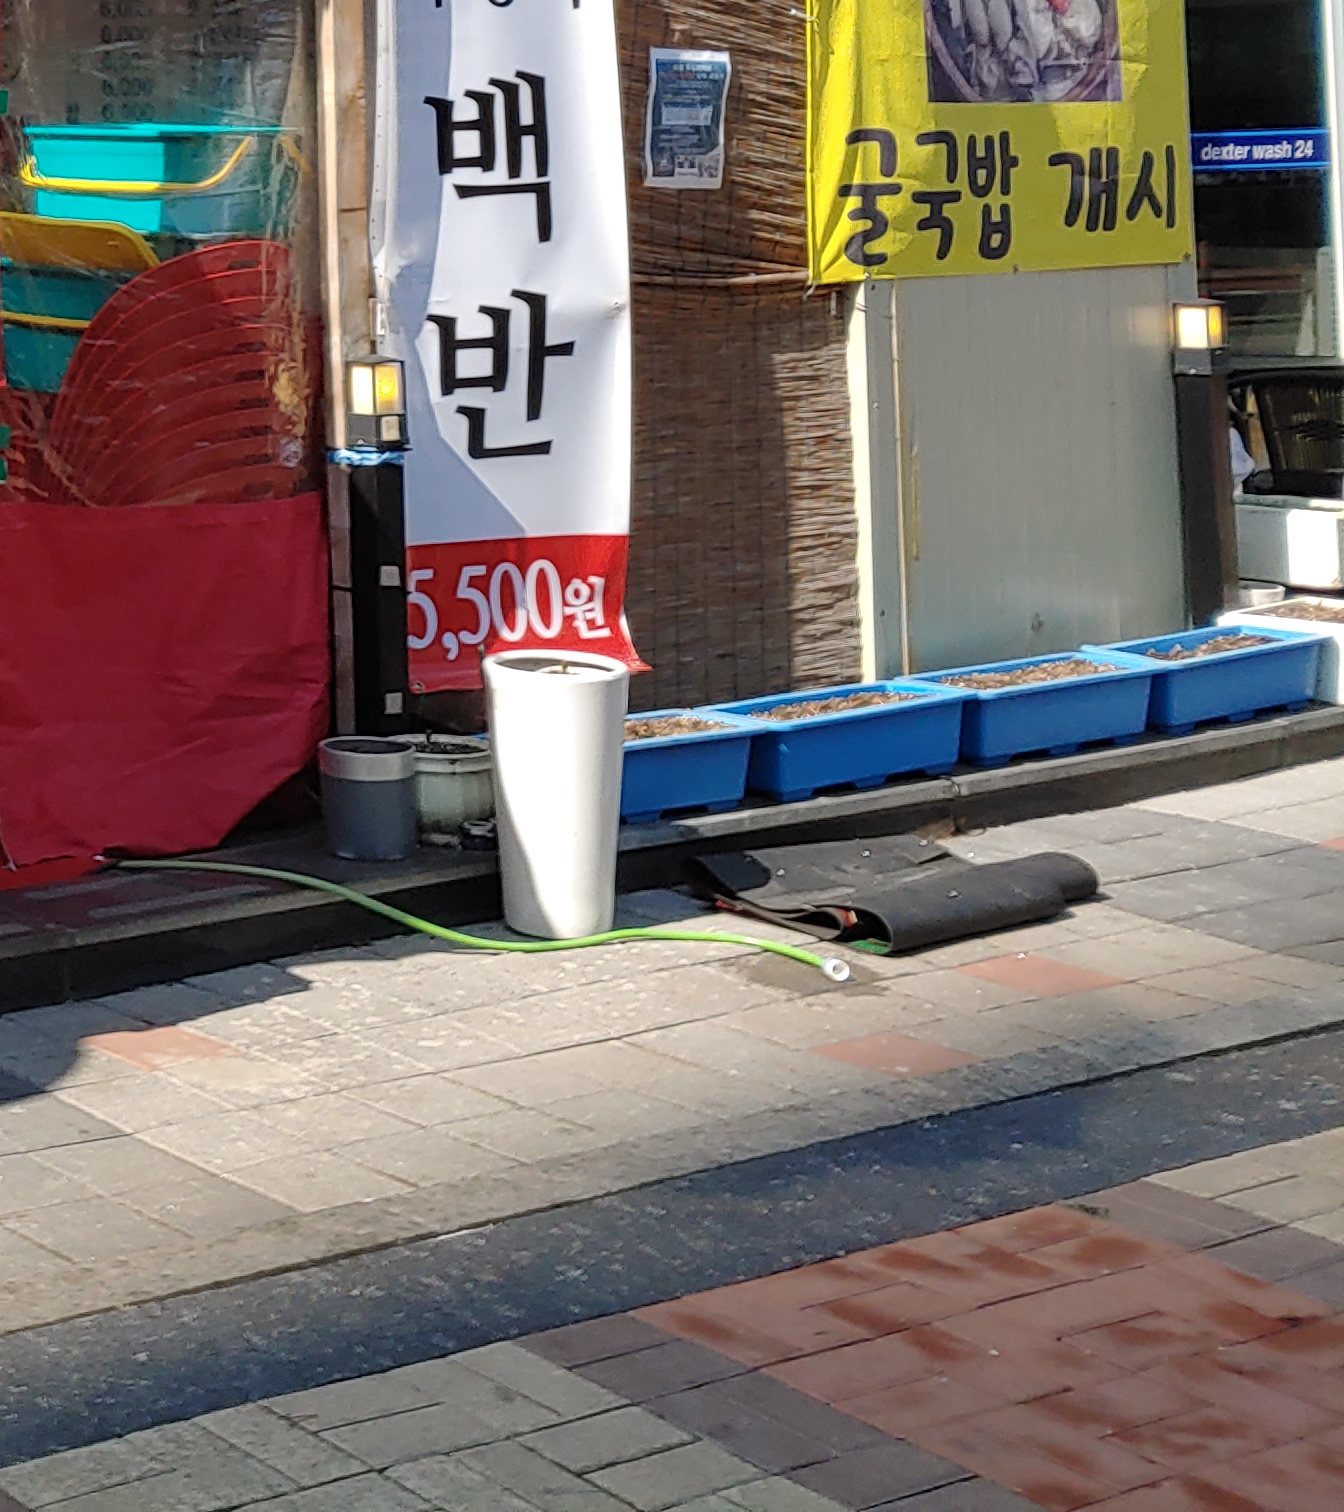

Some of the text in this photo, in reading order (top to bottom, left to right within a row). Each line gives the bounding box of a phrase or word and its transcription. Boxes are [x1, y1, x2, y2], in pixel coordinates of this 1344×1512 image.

[838, 126, 1176, 268] 굴국밥 개시
[1200, 138, 1315, 161] dexter wash 24
[407, 558, 612, 661] 5,500원
